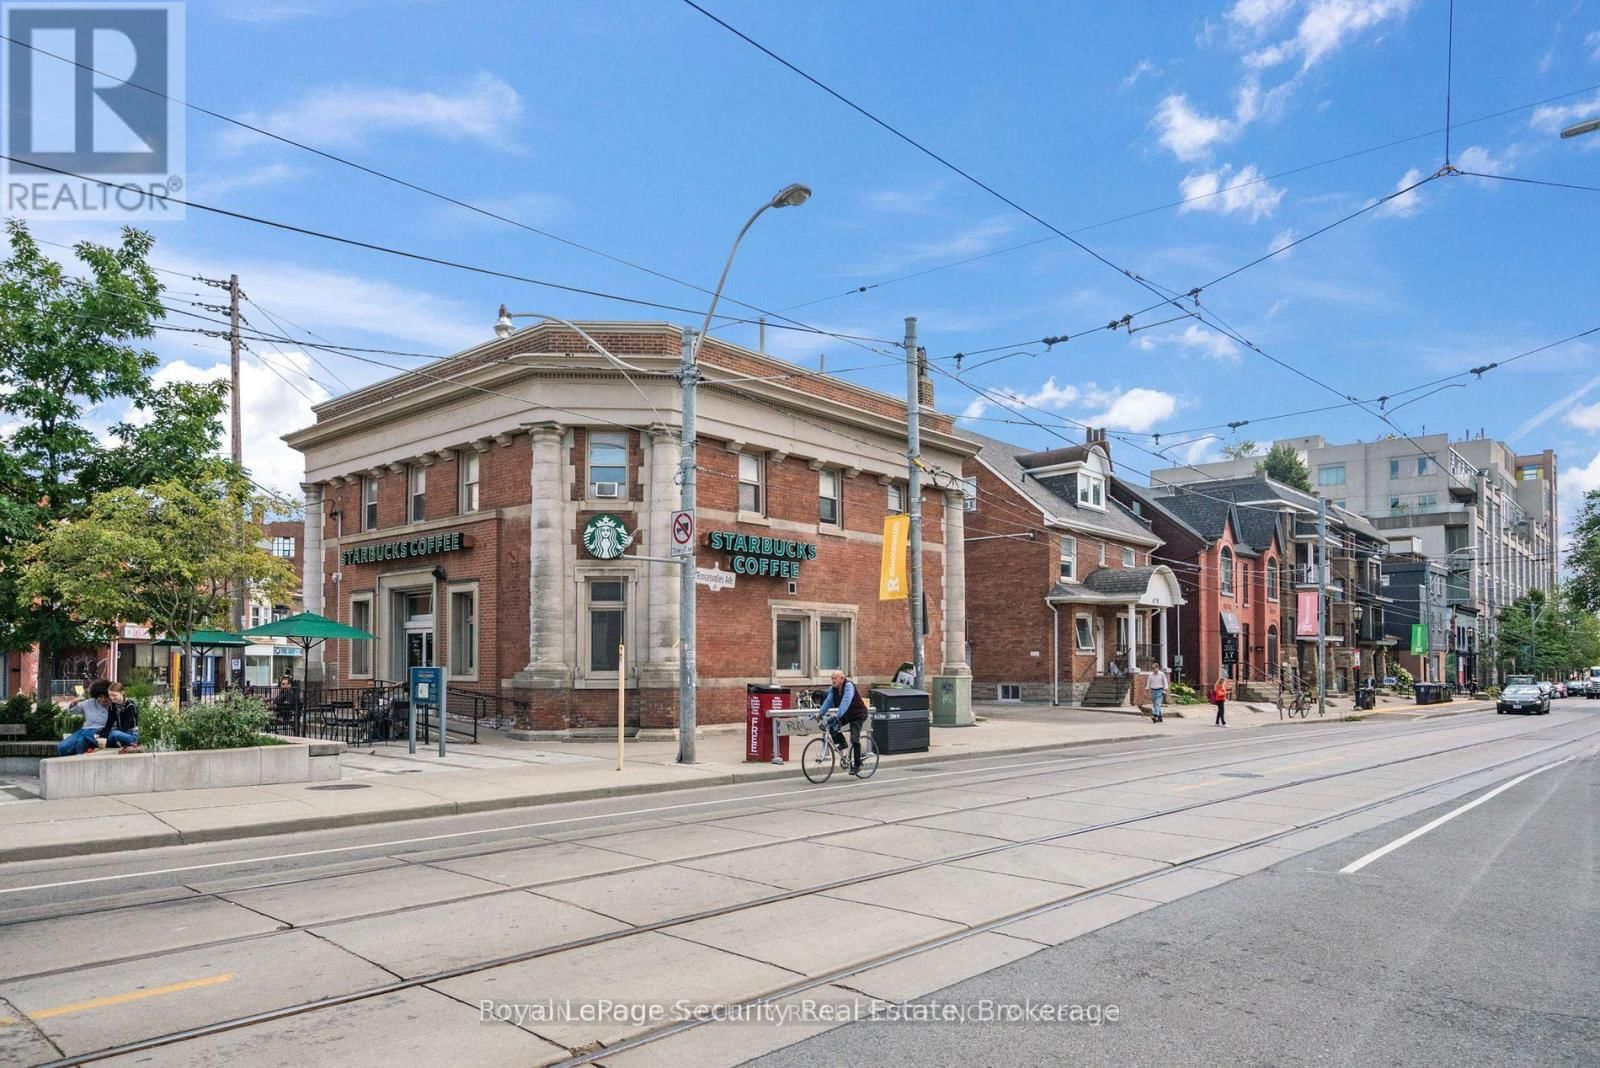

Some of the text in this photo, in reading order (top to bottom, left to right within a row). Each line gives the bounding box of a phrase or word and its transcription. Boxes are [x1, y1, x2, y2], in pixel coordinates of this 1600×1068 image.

[340, 532, 460, 566] STARBUCKS COFFEE
[711, 530, 817, 561] STARBUCKS
[733, 555, 800, 579] COFFEE
[751, 717, 759, 753] FREE
